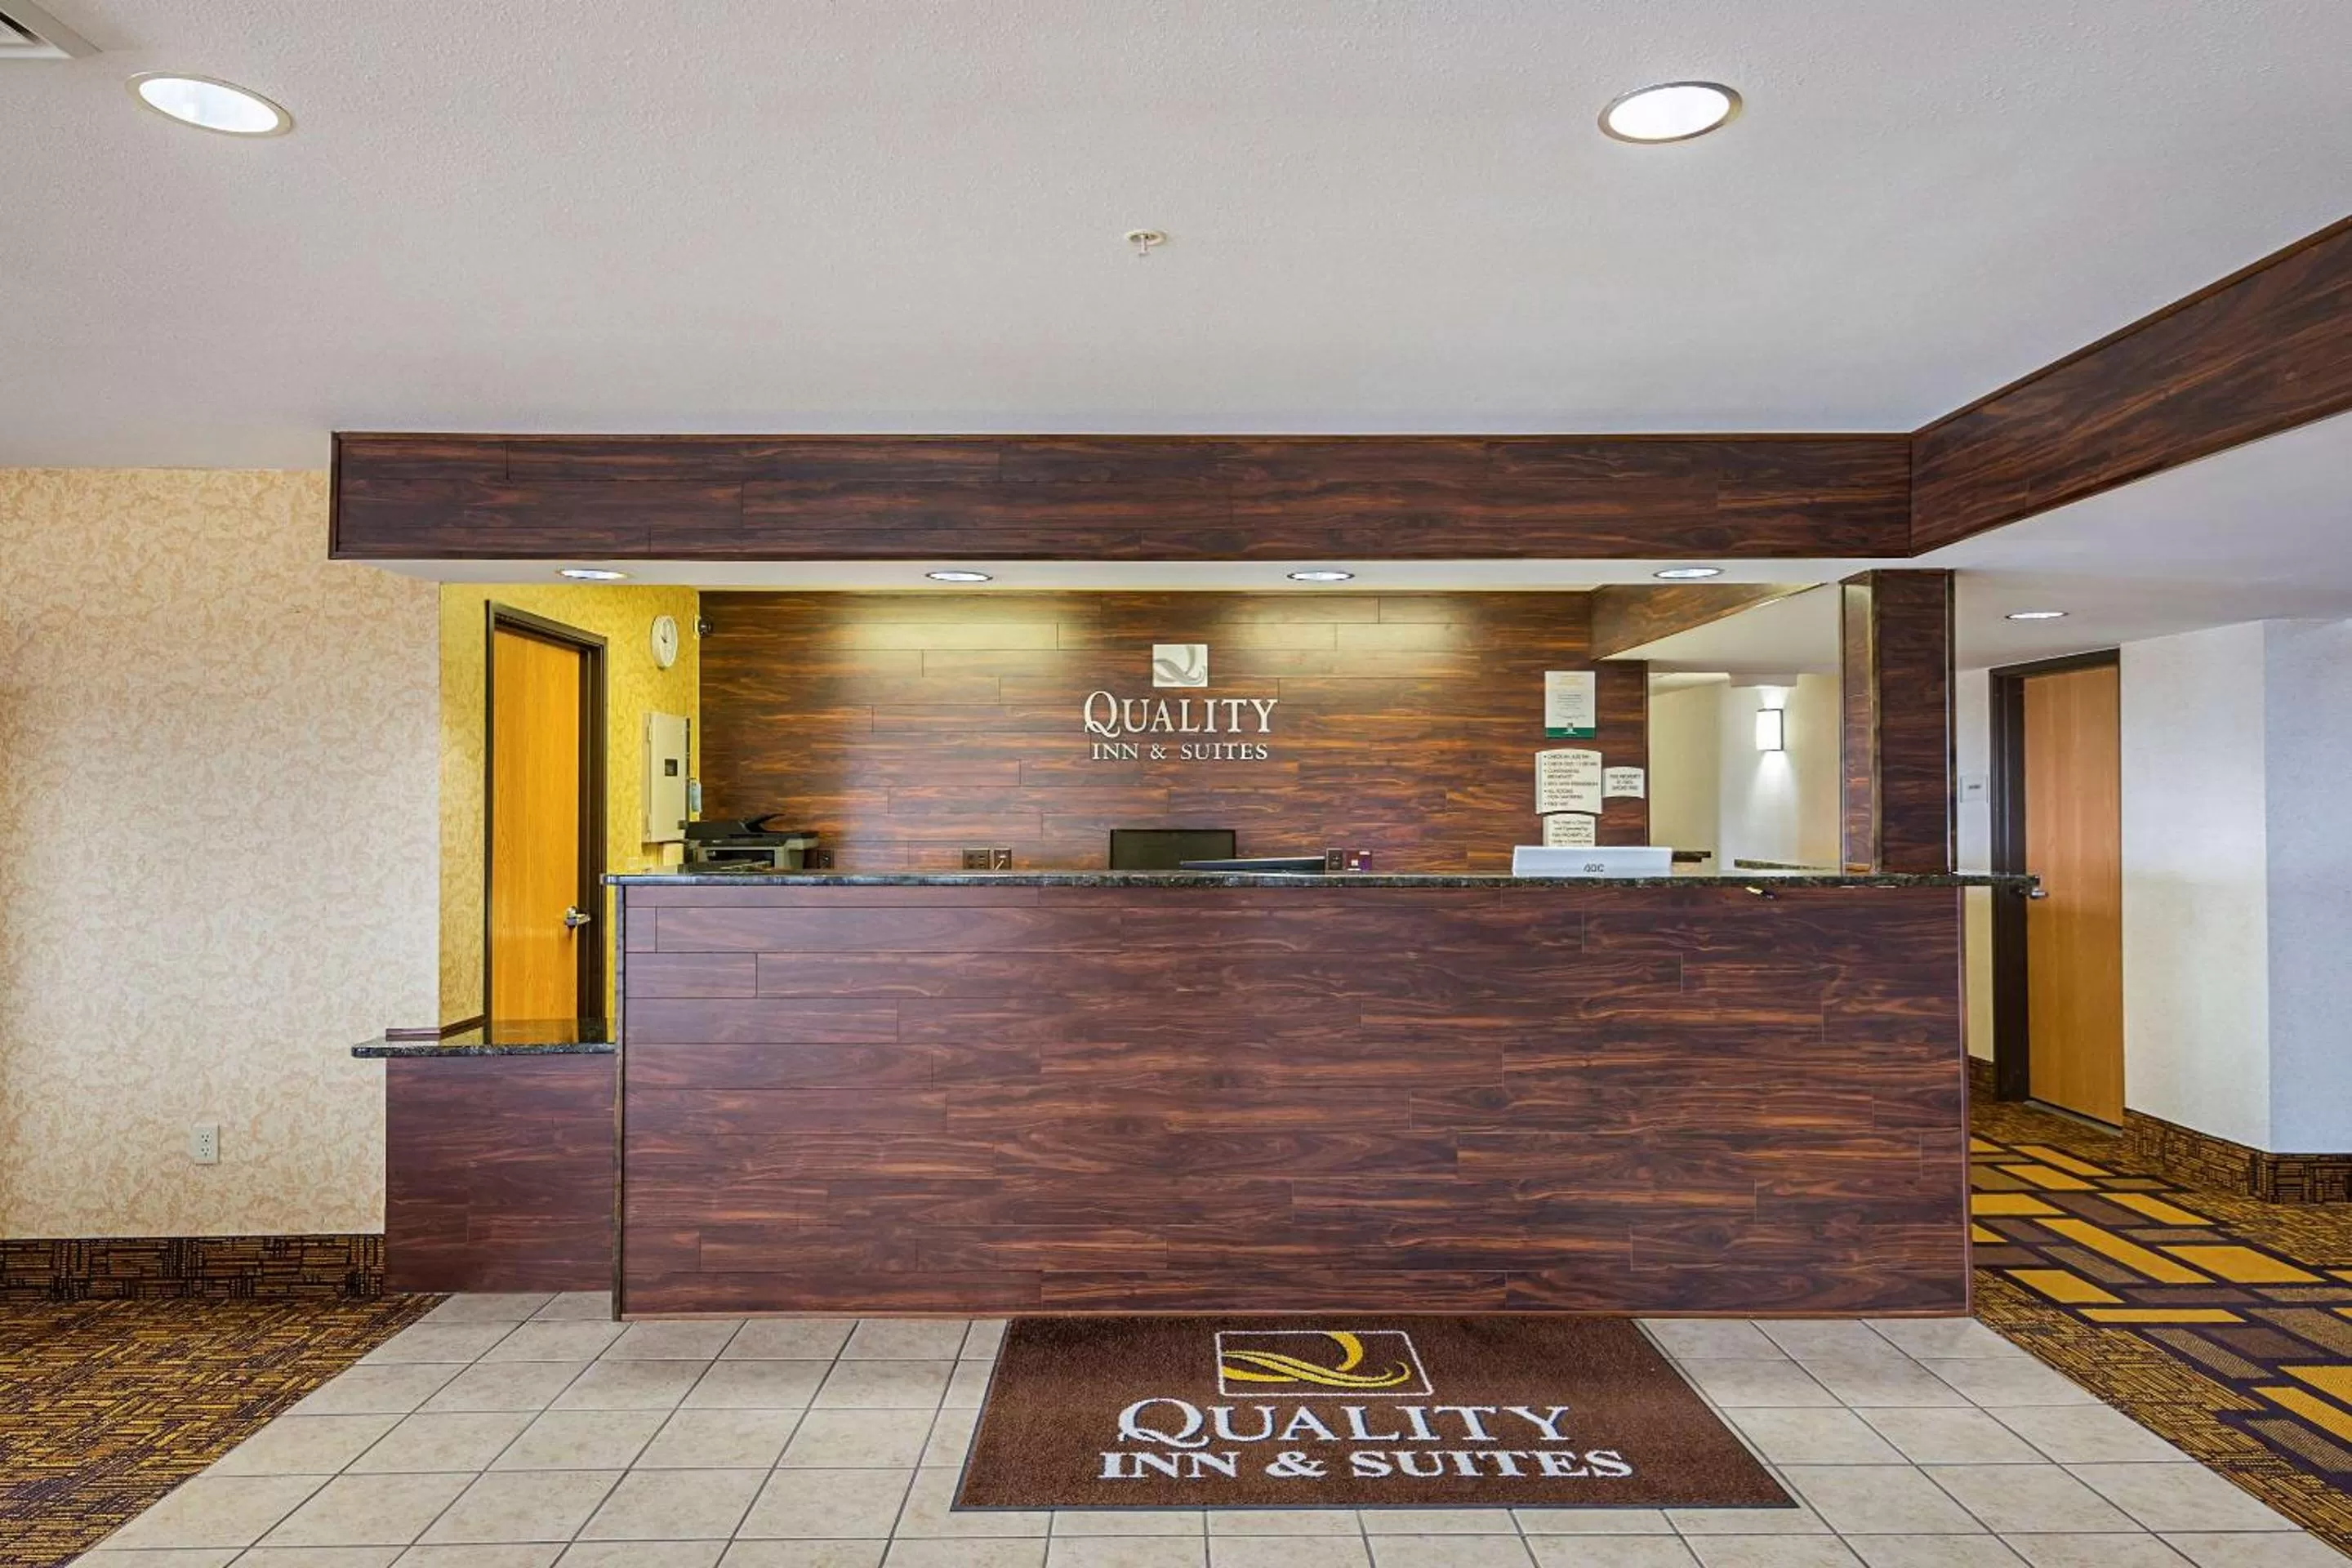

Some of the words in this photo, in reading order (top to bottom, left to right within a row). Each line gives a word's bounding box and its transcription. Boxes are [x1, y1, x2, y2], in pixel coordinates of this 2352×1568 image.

[1084, 691, 1279, 737] QUALITY
[1092, 742, 1139, 760] INN
[1150, 742, 1167, 760] &
[1180, 742, 1268, 760] SUITES
[1117, 1397, 1569, 1448] QUALITY
[1098, 1451, 1241, 1478] INN
[1265, 1450, 1329, 1478] &
[1348, 1450, 1633, 1478] SUITES
